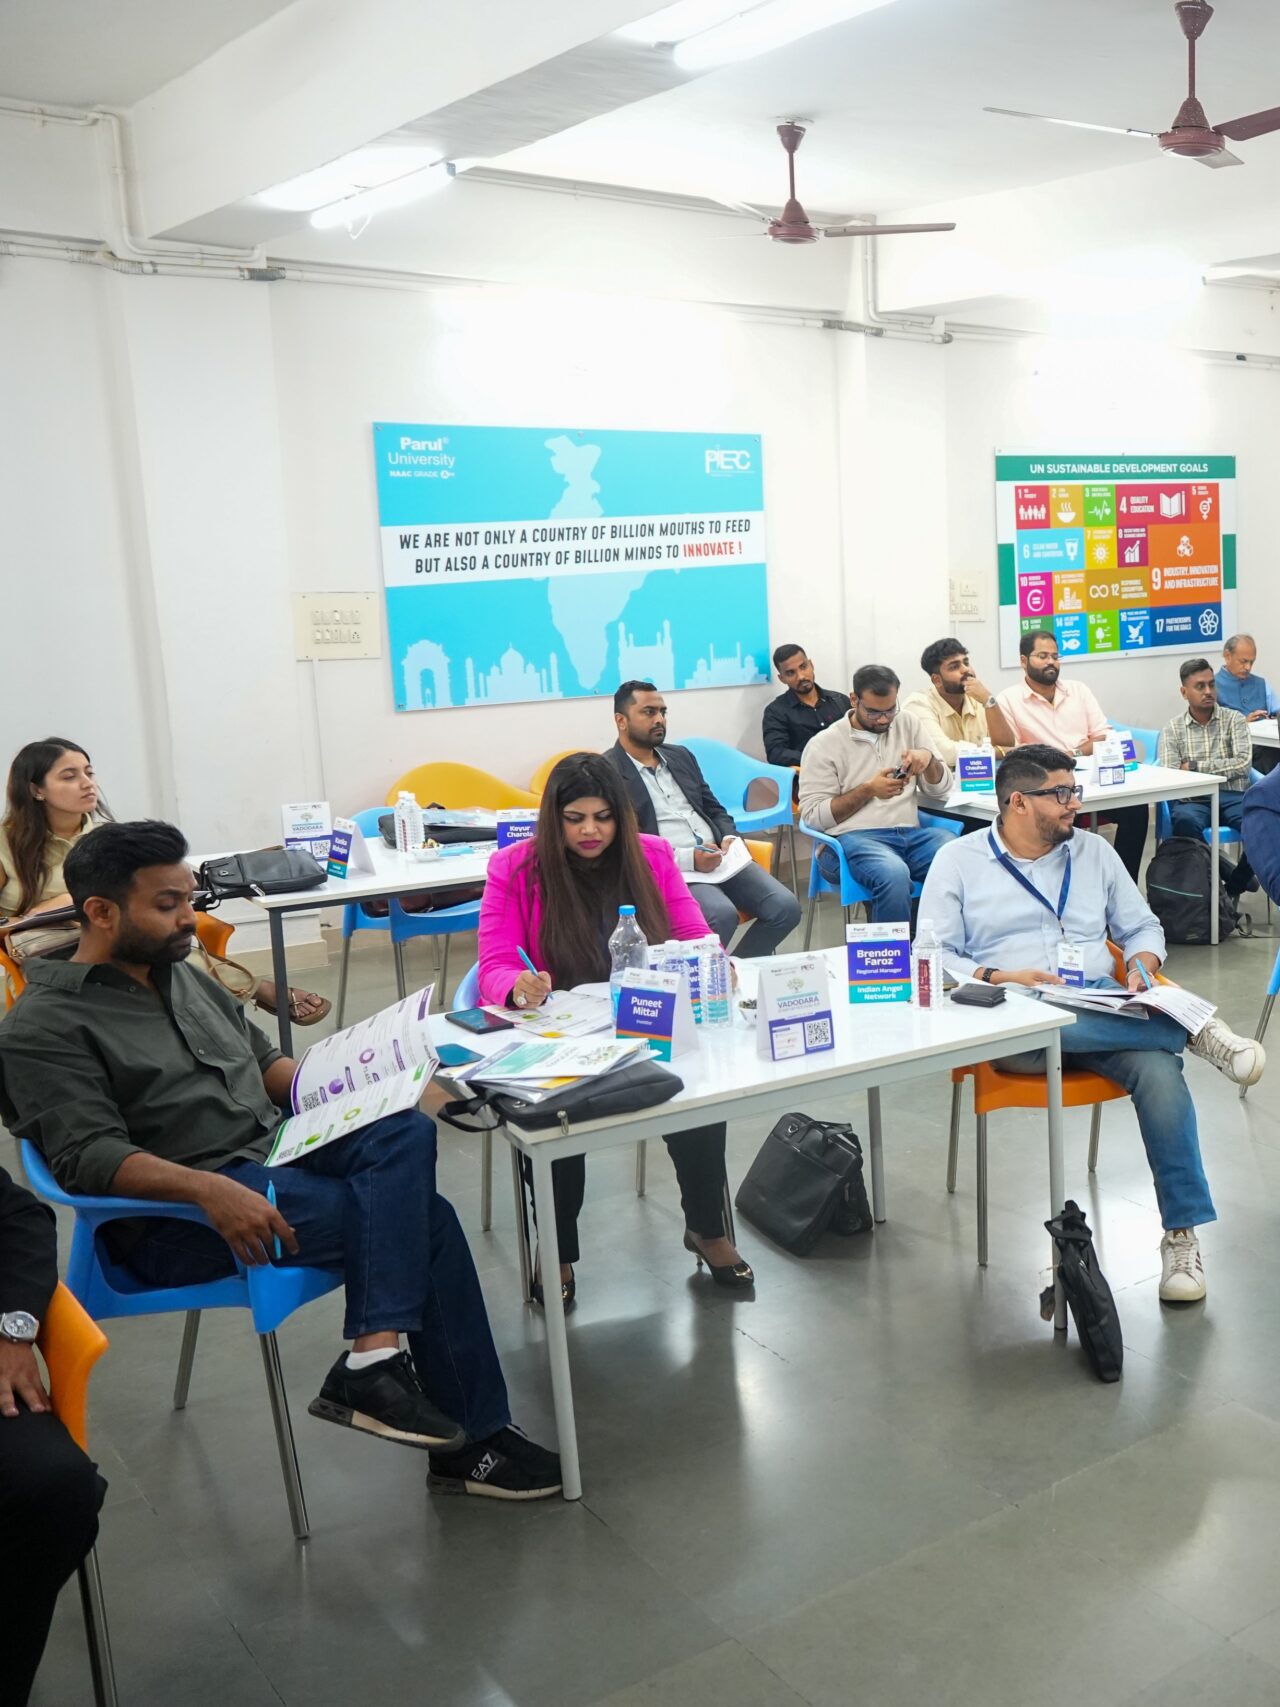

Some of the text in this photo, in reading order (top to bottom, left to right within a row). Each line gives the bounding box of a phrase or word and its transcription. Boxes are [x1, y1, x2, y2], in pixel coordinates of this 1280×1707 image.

[400, 436, 443, 451] Parul
[387, 451, 456, 469] University
[389, 470, 413, 478] NAAC
[414, 470, 439, 478] GRADE
[1030, 463, 1209, 474] UN SUSTAINABLE DEVELOPMENT GOALS
[1191, 485, 1197, 496] 5
[1119, 496, 1127, 514] 4
[399, 518, 751, 549] WE ARE NOT ONLY A COUNTRY OF BILLION MOUTHS TO FEED
[415, 558, 441, 574] BUT
[444, 555, 477, 572] ALSO
[481, 554, 490, 570] A
[494, 551, 551, 569] COUNTRY
[555, 550, 570, 565] OF
[574, 547, 620, 564] BILLION
[624, 545, 662, 561] MINDS
[666, 544, 679, 559] TO
[683, 541, 735, 558] INNOVATE
[1023, 543, 1030, 559] 6
[1020, 576, 1028, 587] 10
[1152, 567, 1161, 590] 9
[1111, 583, 1119, 597] 12
[1155, 618, 1164, 633] 17
[856, 948, 901, 958] Brendon
[864, 957, 894, 966] Faroz
[857, 984, 903, 993] Indian Angel
[863, 991, 897, 1000] Network
[631, 996, 663, 1009] Puneet
[776, 995, 820, 1009] VADODARA
[632, 1006, 658, 1018] Mittal
[471, 1452, 494, 1480] EA7
